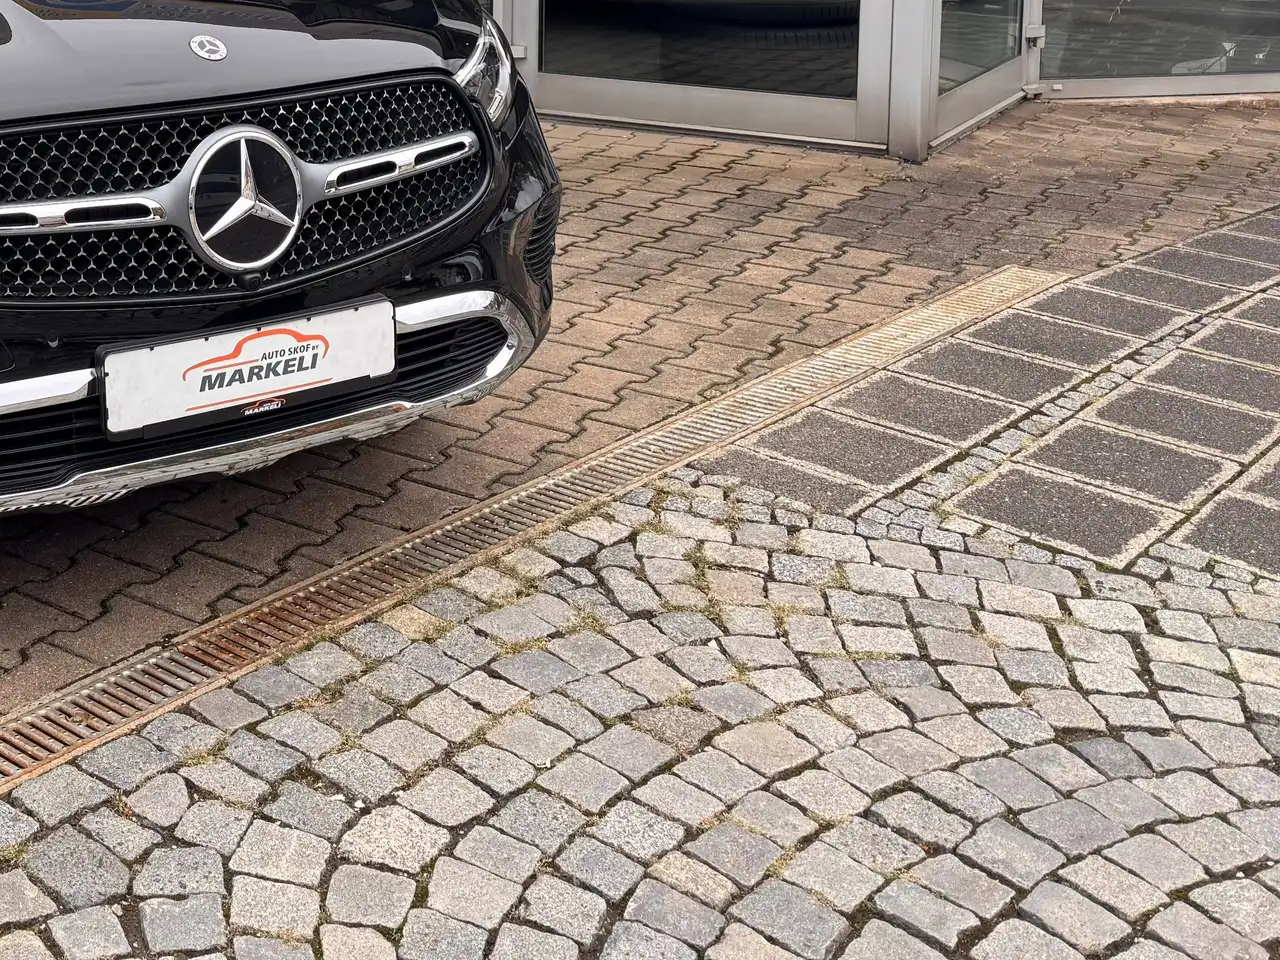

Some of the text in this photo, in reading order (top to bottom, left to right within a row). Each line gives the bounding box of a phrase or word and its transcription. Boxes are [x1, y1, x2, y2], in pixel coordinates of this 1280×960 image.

[261, 349, 286, 361] AUTO
[288, 343, 311, 356] SKOF
[199, 353, 319, 393] MARKELI
[244, 401, 282, 416] MARKELI
